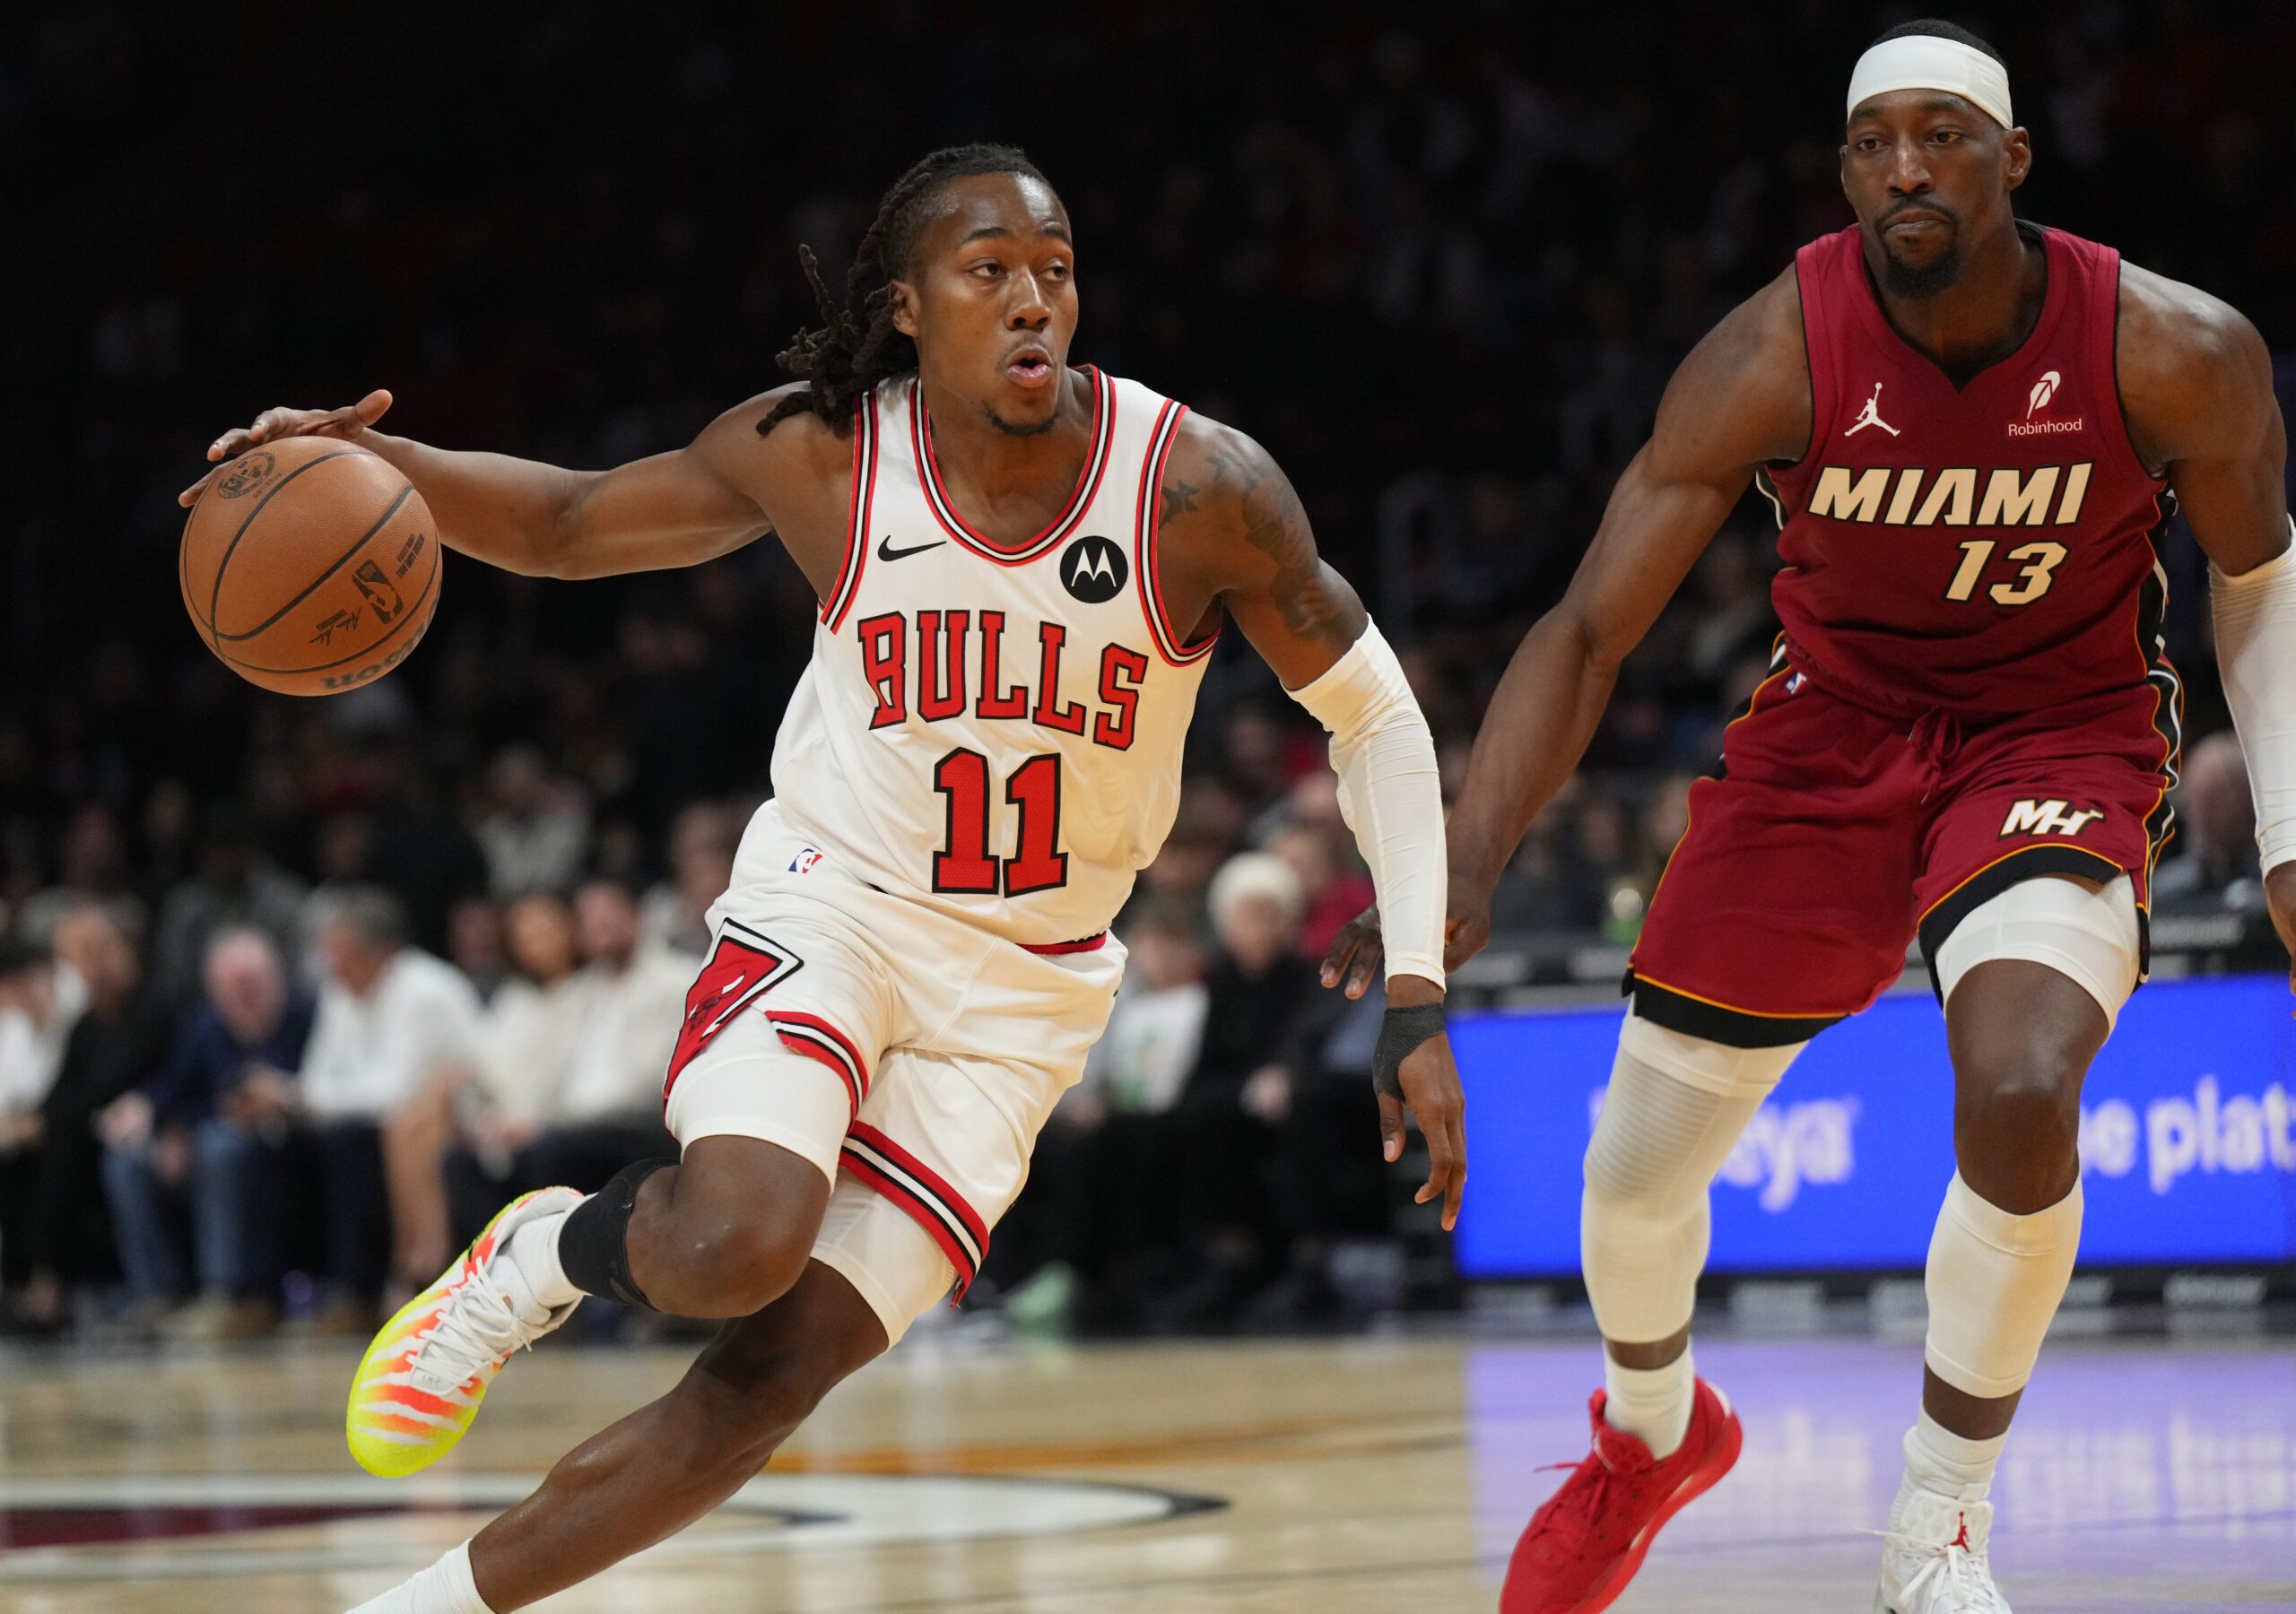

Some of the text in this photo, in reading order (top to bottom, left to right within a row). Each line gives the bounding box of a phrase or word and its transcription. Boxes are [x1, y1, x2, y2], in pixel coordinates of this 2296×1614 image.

[2008, 418, 2083, 437] Robinhood
[1806, 461, 2096, 527] MIAMI
[1944, 539, 2069, 605] 13
[858, 610, 1148, 751] BULLS
[933, 746, 1068, 898] 11
